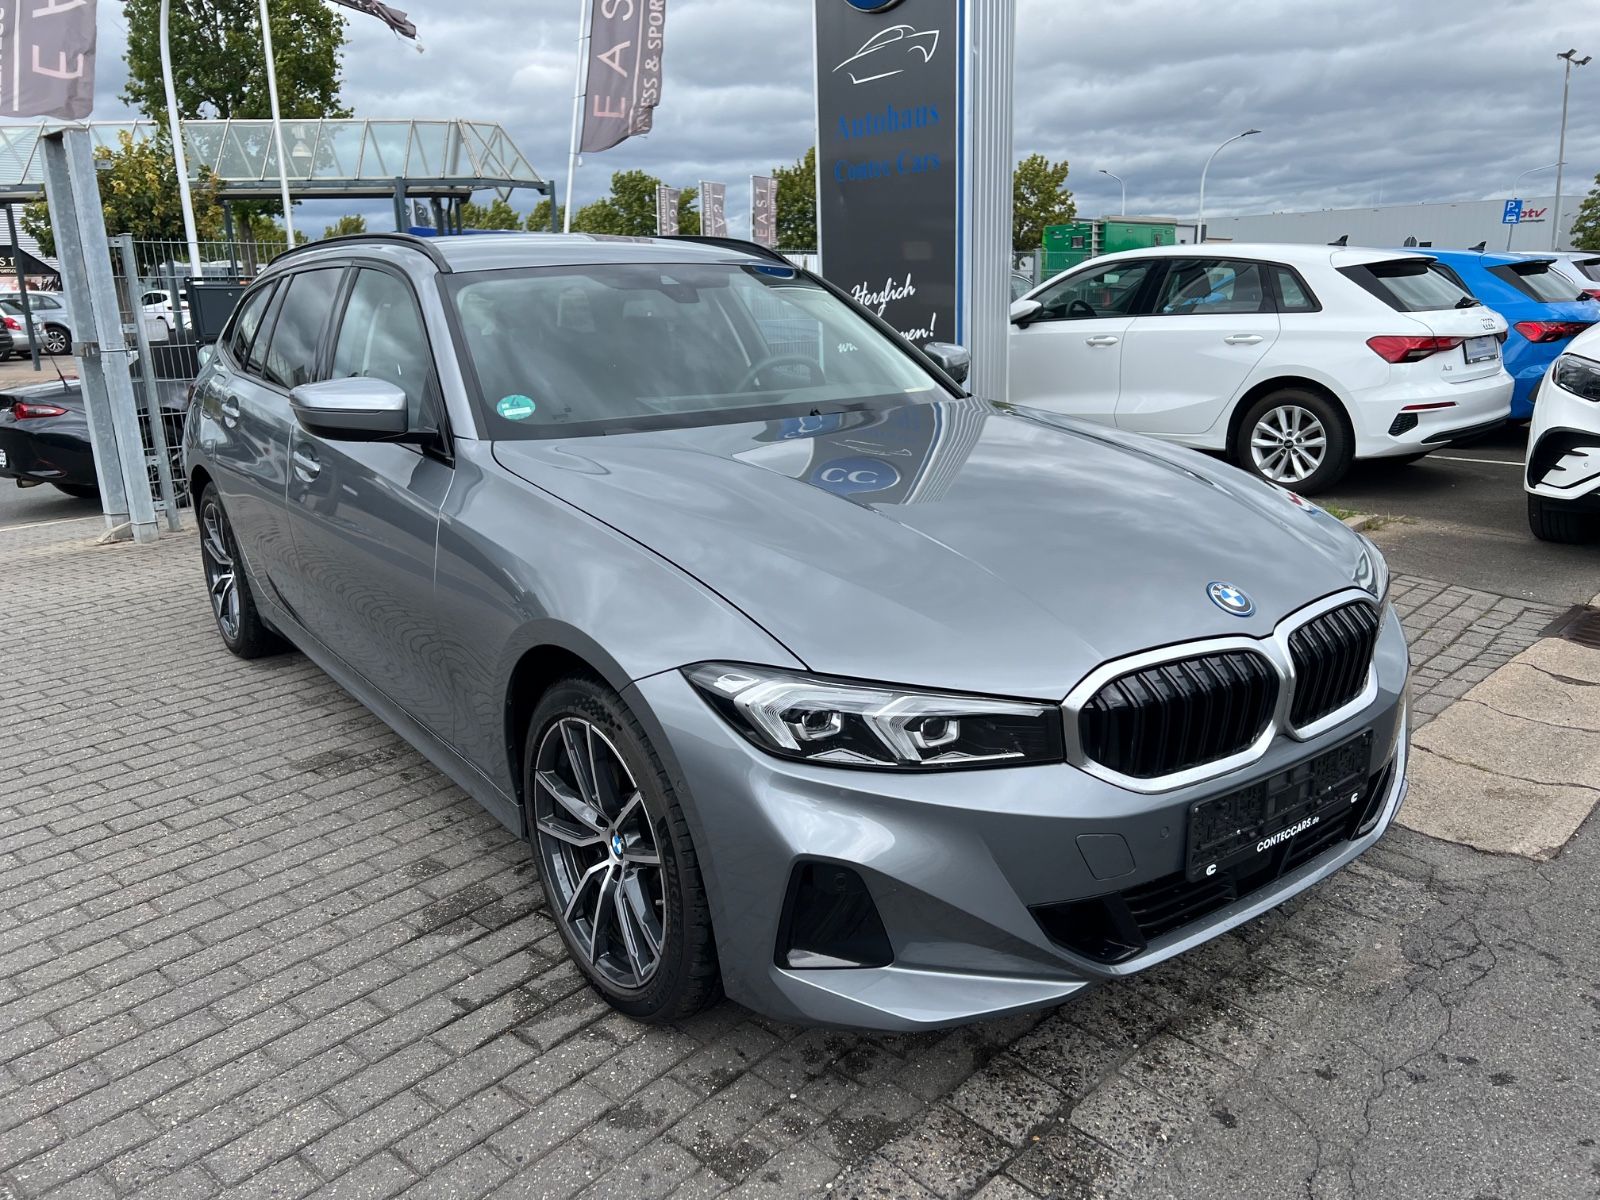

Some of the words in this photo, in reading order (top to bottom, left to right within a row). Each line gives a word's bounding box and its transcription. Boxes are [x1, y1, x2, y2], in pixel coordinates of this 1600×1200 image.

[837, 103, 940, 139] Autohaus
[896, 149, 941, 175] Cars
[756, 186, 769, 237] EAST
[1507, 201, 1516, 211] P
[851, 273, 916, 318] Herzlich
[1256, 816, 1320, 853] CONTECCARS.de
